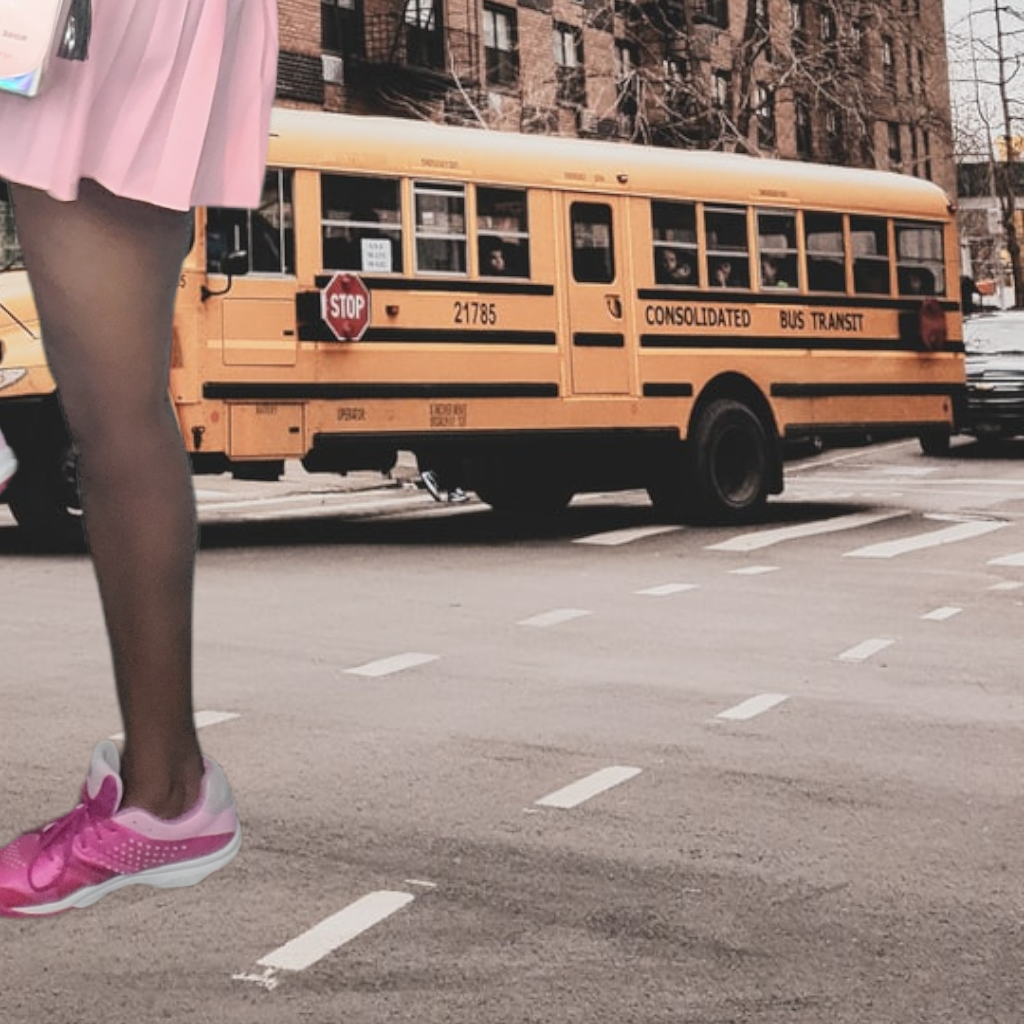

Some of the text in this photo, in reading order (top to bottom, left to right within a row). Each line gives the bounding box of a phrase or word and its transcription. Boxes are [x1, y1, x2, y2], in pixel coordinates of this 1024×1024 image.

[329, 293, 365, 319] STOP
[454, 301, 497, 325] 21785
[645, 305, 864, 331] CONSOLIDATED BUS TRANSIT
